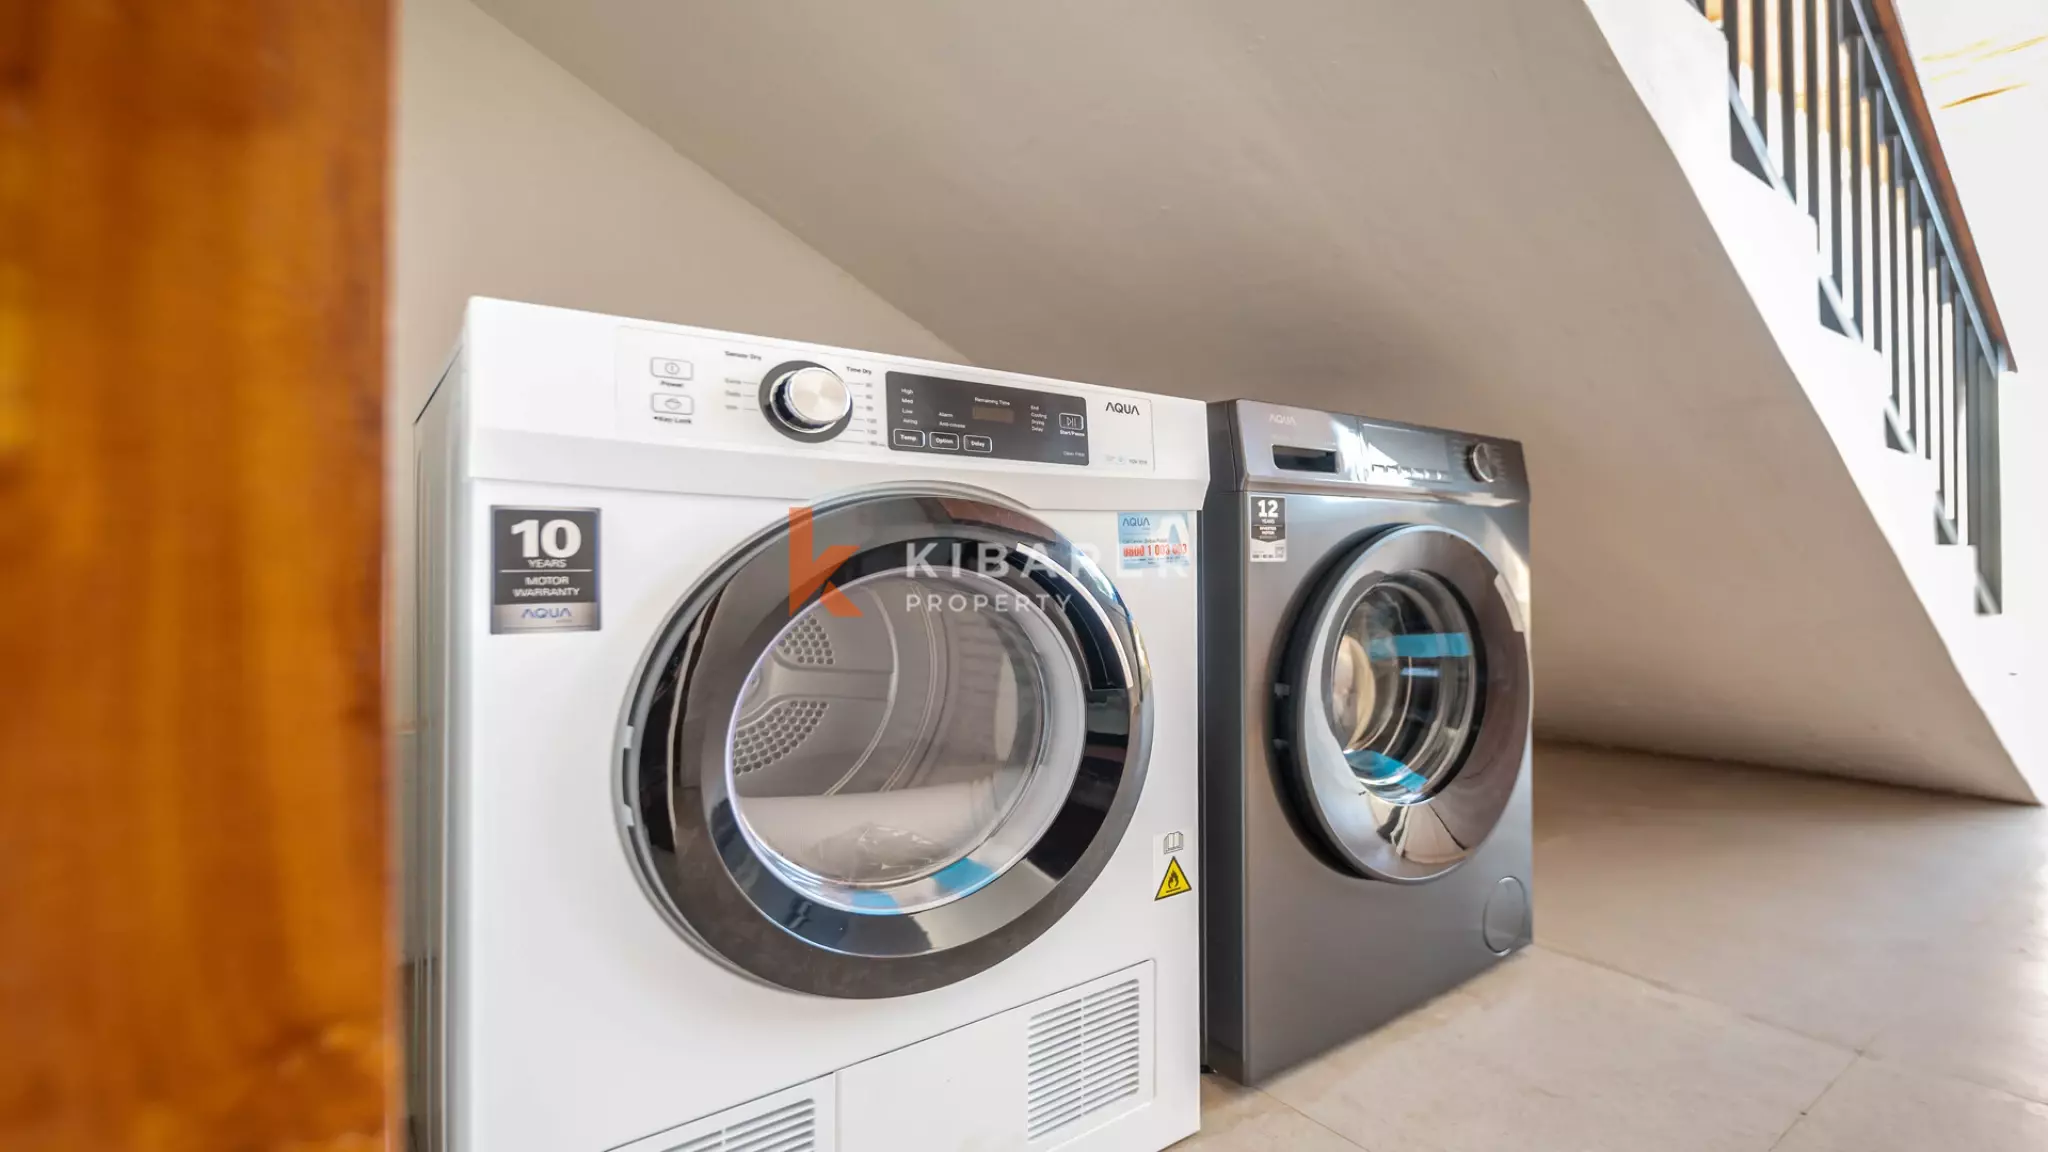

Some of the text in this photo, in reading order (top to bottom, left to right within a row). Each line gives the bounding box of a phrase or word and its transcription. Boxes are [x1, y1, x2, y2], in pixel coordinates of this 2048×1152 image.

[846, 366, 873, 376] Time Dry
[974, 397, 999, 405] Remaining
[1105, 402, 1140, 416] AQUA
[1269, 413, 1297, 426] AQUA
[936, 437, 954, 445] Option
[971, 440, 985, 448] Delay
[1257, 499, 1279, 518] 12
[1122, 516, 1150, 527] AQUA
[511, 519, 582, 558] 10
[1147, 545, 1152, 556] 1
[528, 559, 568, 569] YEARS
[524, 576, 570, 586] MOTOR
[512, 587, 581, 598] WARRANTY
[521, 607, 573, 619] AQUA
